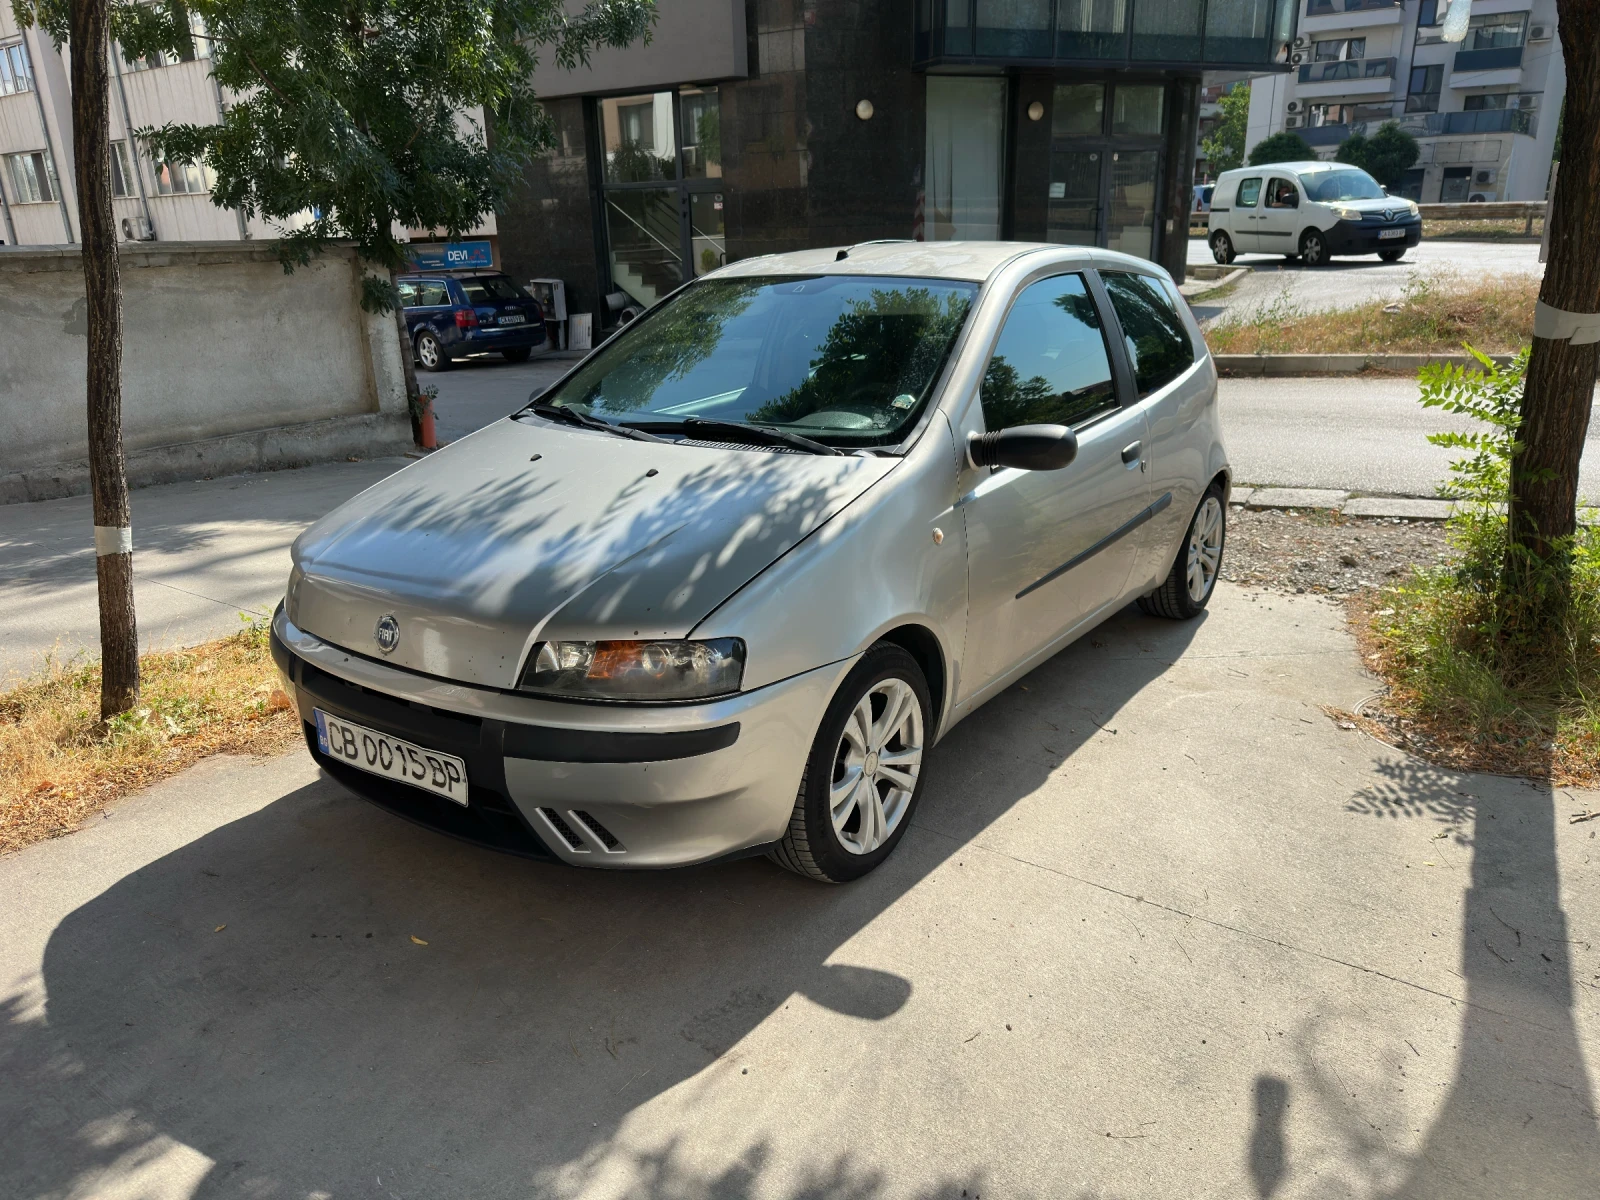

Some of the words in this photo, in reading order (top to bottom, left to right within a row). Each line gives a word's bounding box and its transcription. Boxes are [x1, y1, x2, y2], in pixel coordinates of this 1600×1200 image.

[448, 250, 468, 262] DEVI
[378, 627, 394, 642] FIAT
[319, 734, 328, 748] BG
